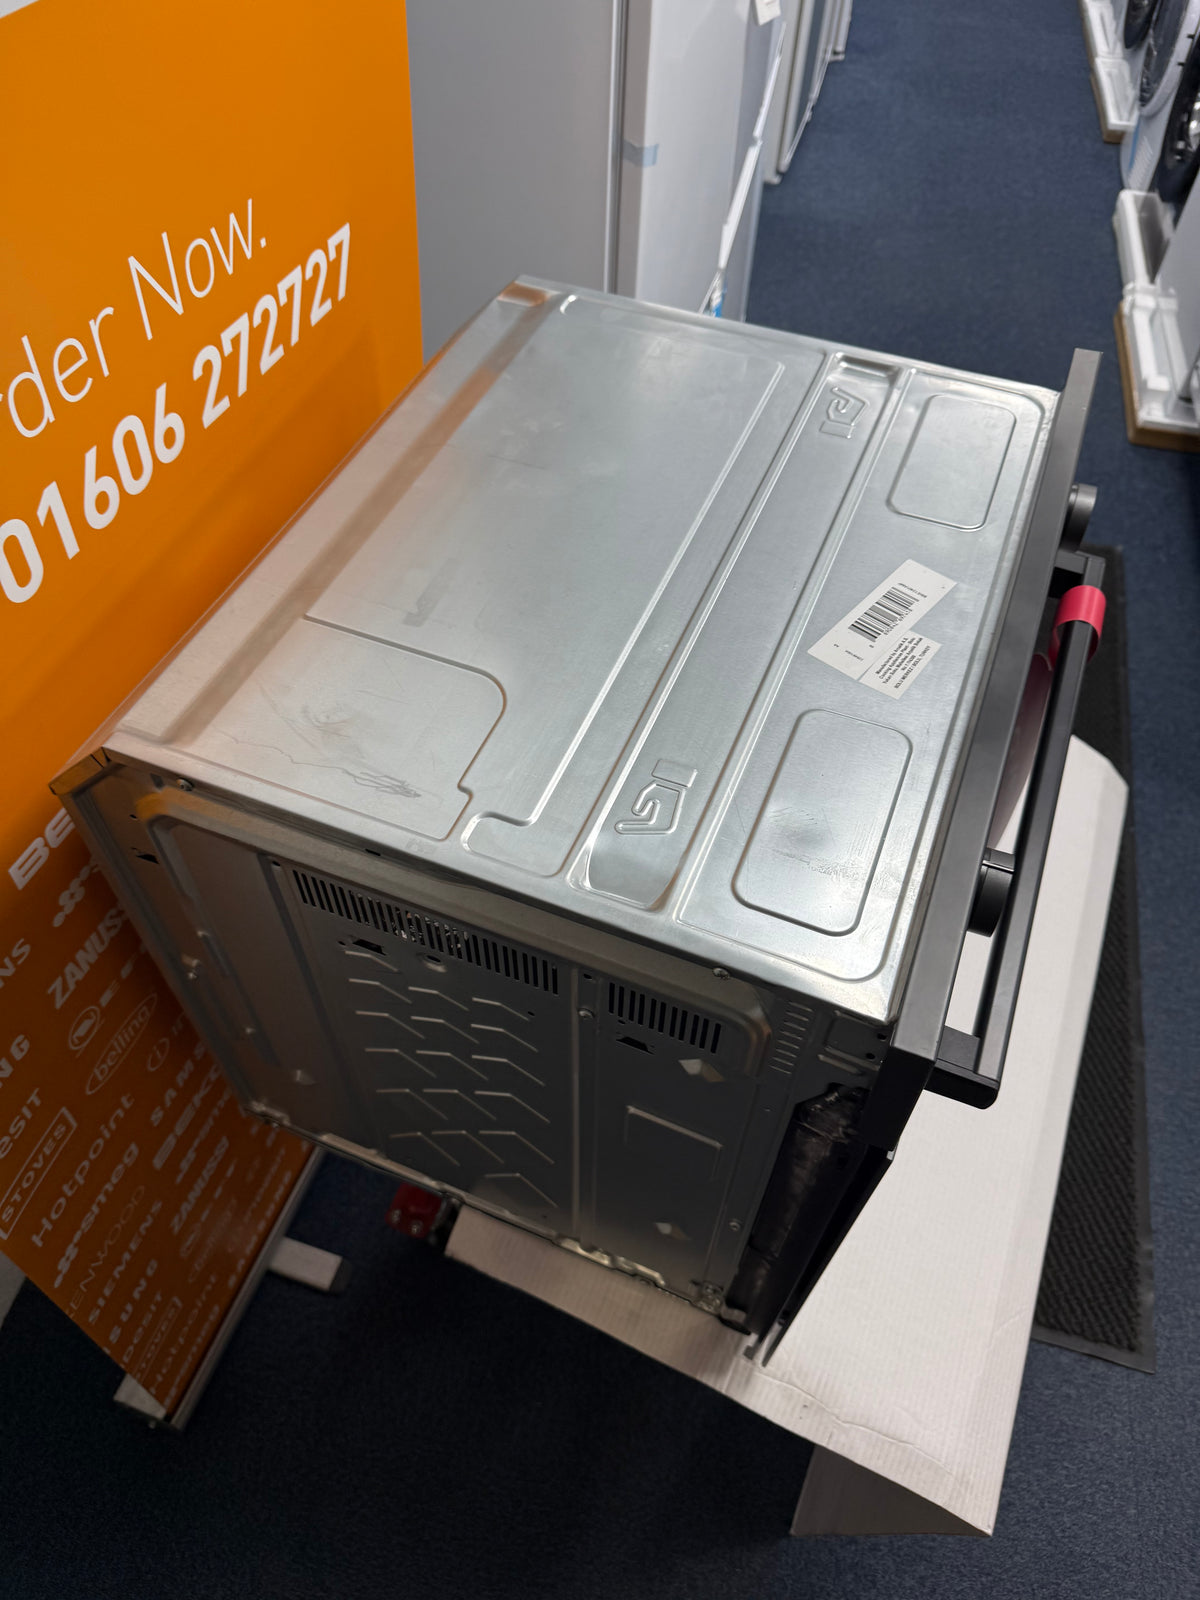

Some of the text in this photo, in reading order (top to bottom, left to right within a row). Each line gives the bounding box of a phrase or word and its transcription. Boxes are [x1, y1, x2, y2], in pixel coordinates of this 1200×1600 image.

[0, 198, 267, 438] der Now.
[0, 222, 351, 603] 01606 272727
[47, 904, 130, 1009] ZANUS
[2, 1123, 67, 1222] STOVES
[31, 1093, 135, 1247] Hotpoint
[88, 1200, 162, 1326] SIEMENS
[102, 1258, 159, 1354] SUNG
